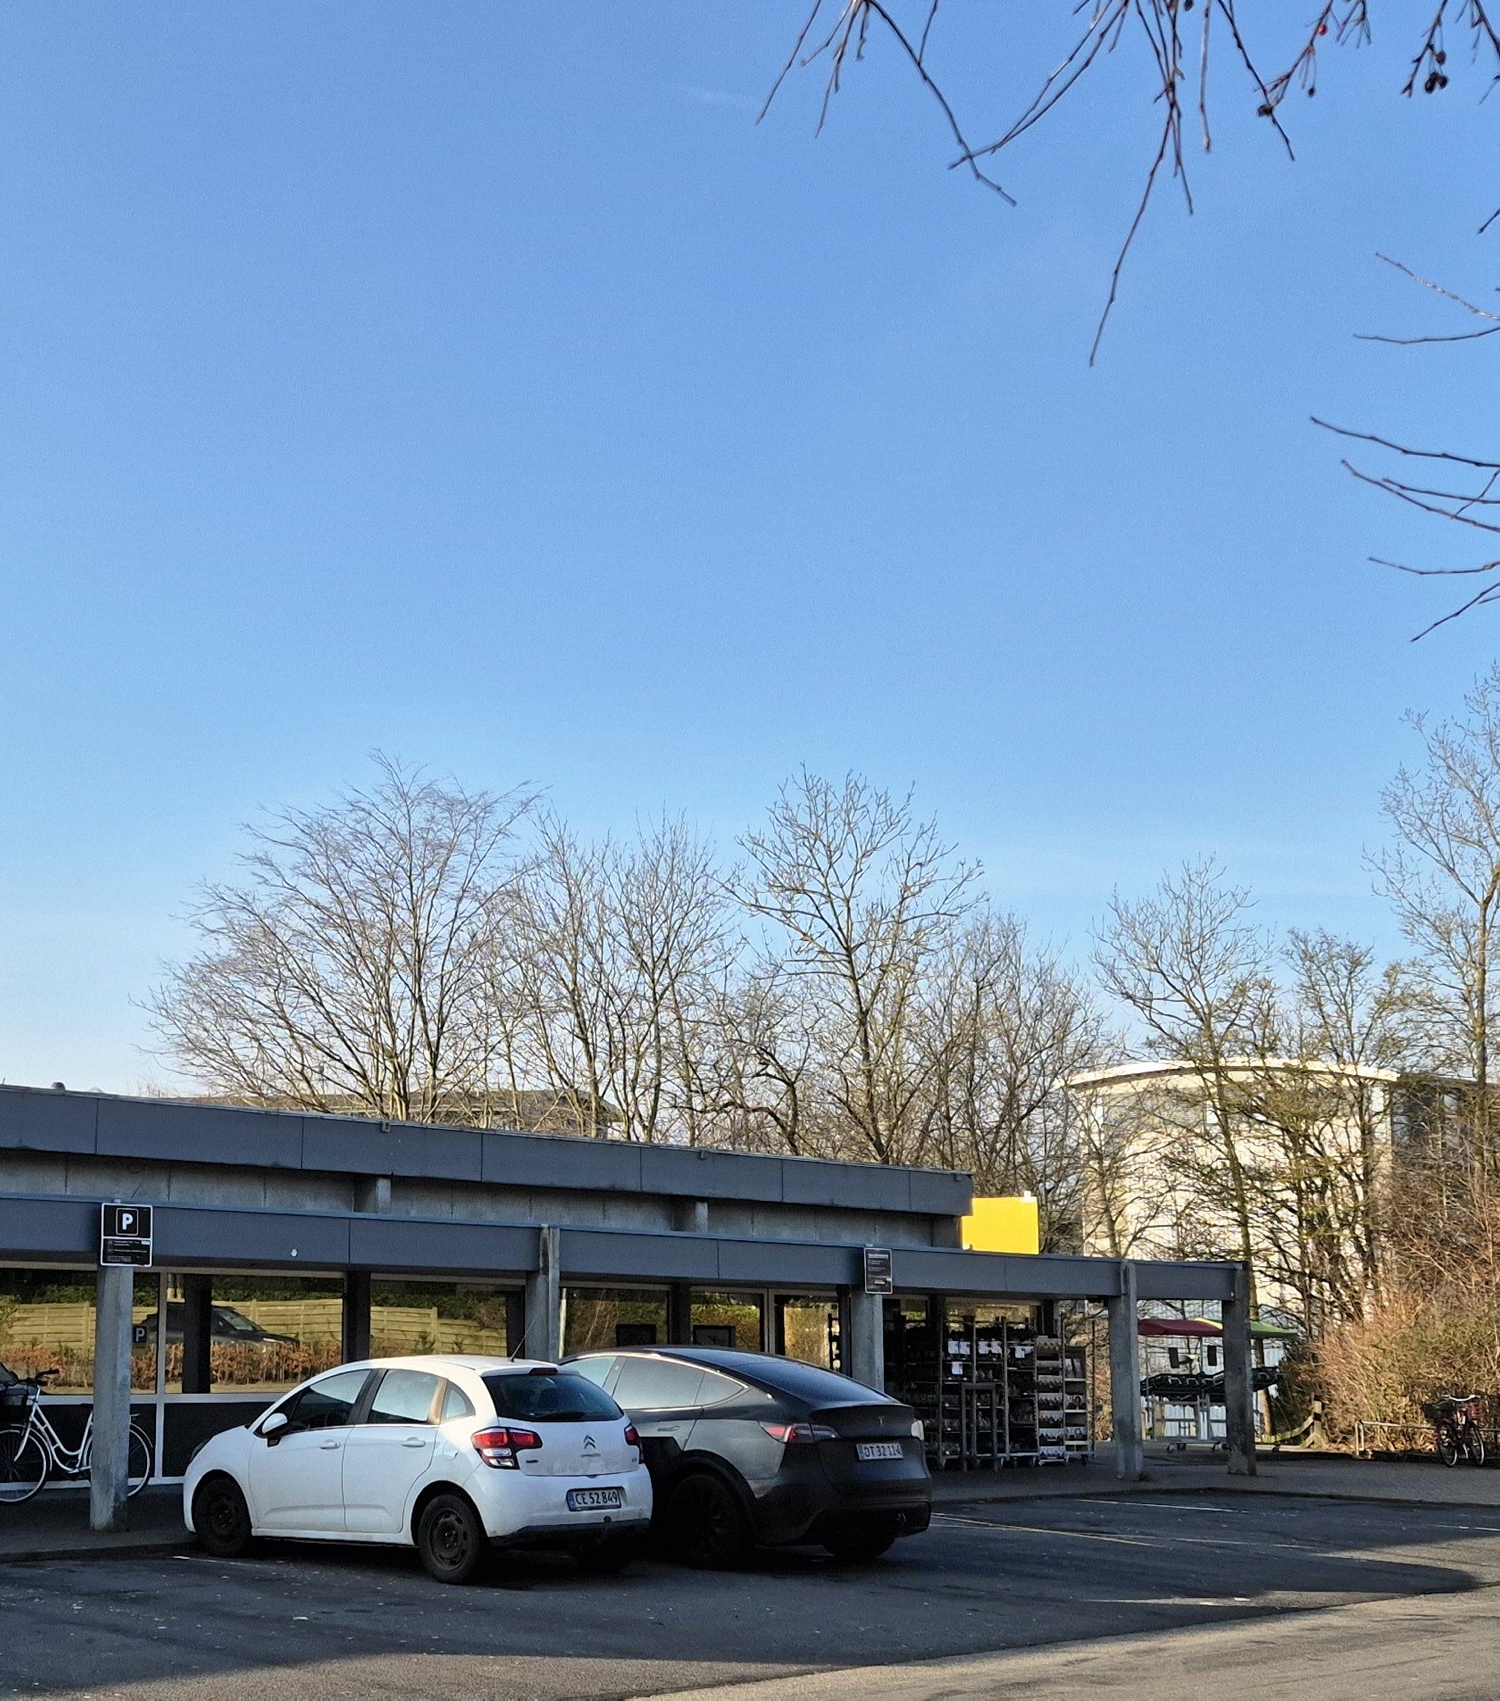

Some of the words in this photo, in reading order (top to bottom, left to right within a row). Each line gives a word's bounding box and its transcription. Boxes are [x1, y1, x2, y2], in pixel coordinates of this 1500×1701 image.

[121, 1212, 134, 1231] P
[135, 1327, 145, 1342] P
[575, 1492, 588, 1505] CE
[589, 1491, 601, 1504] 52
[601, 1491, 618, 1504] 849
